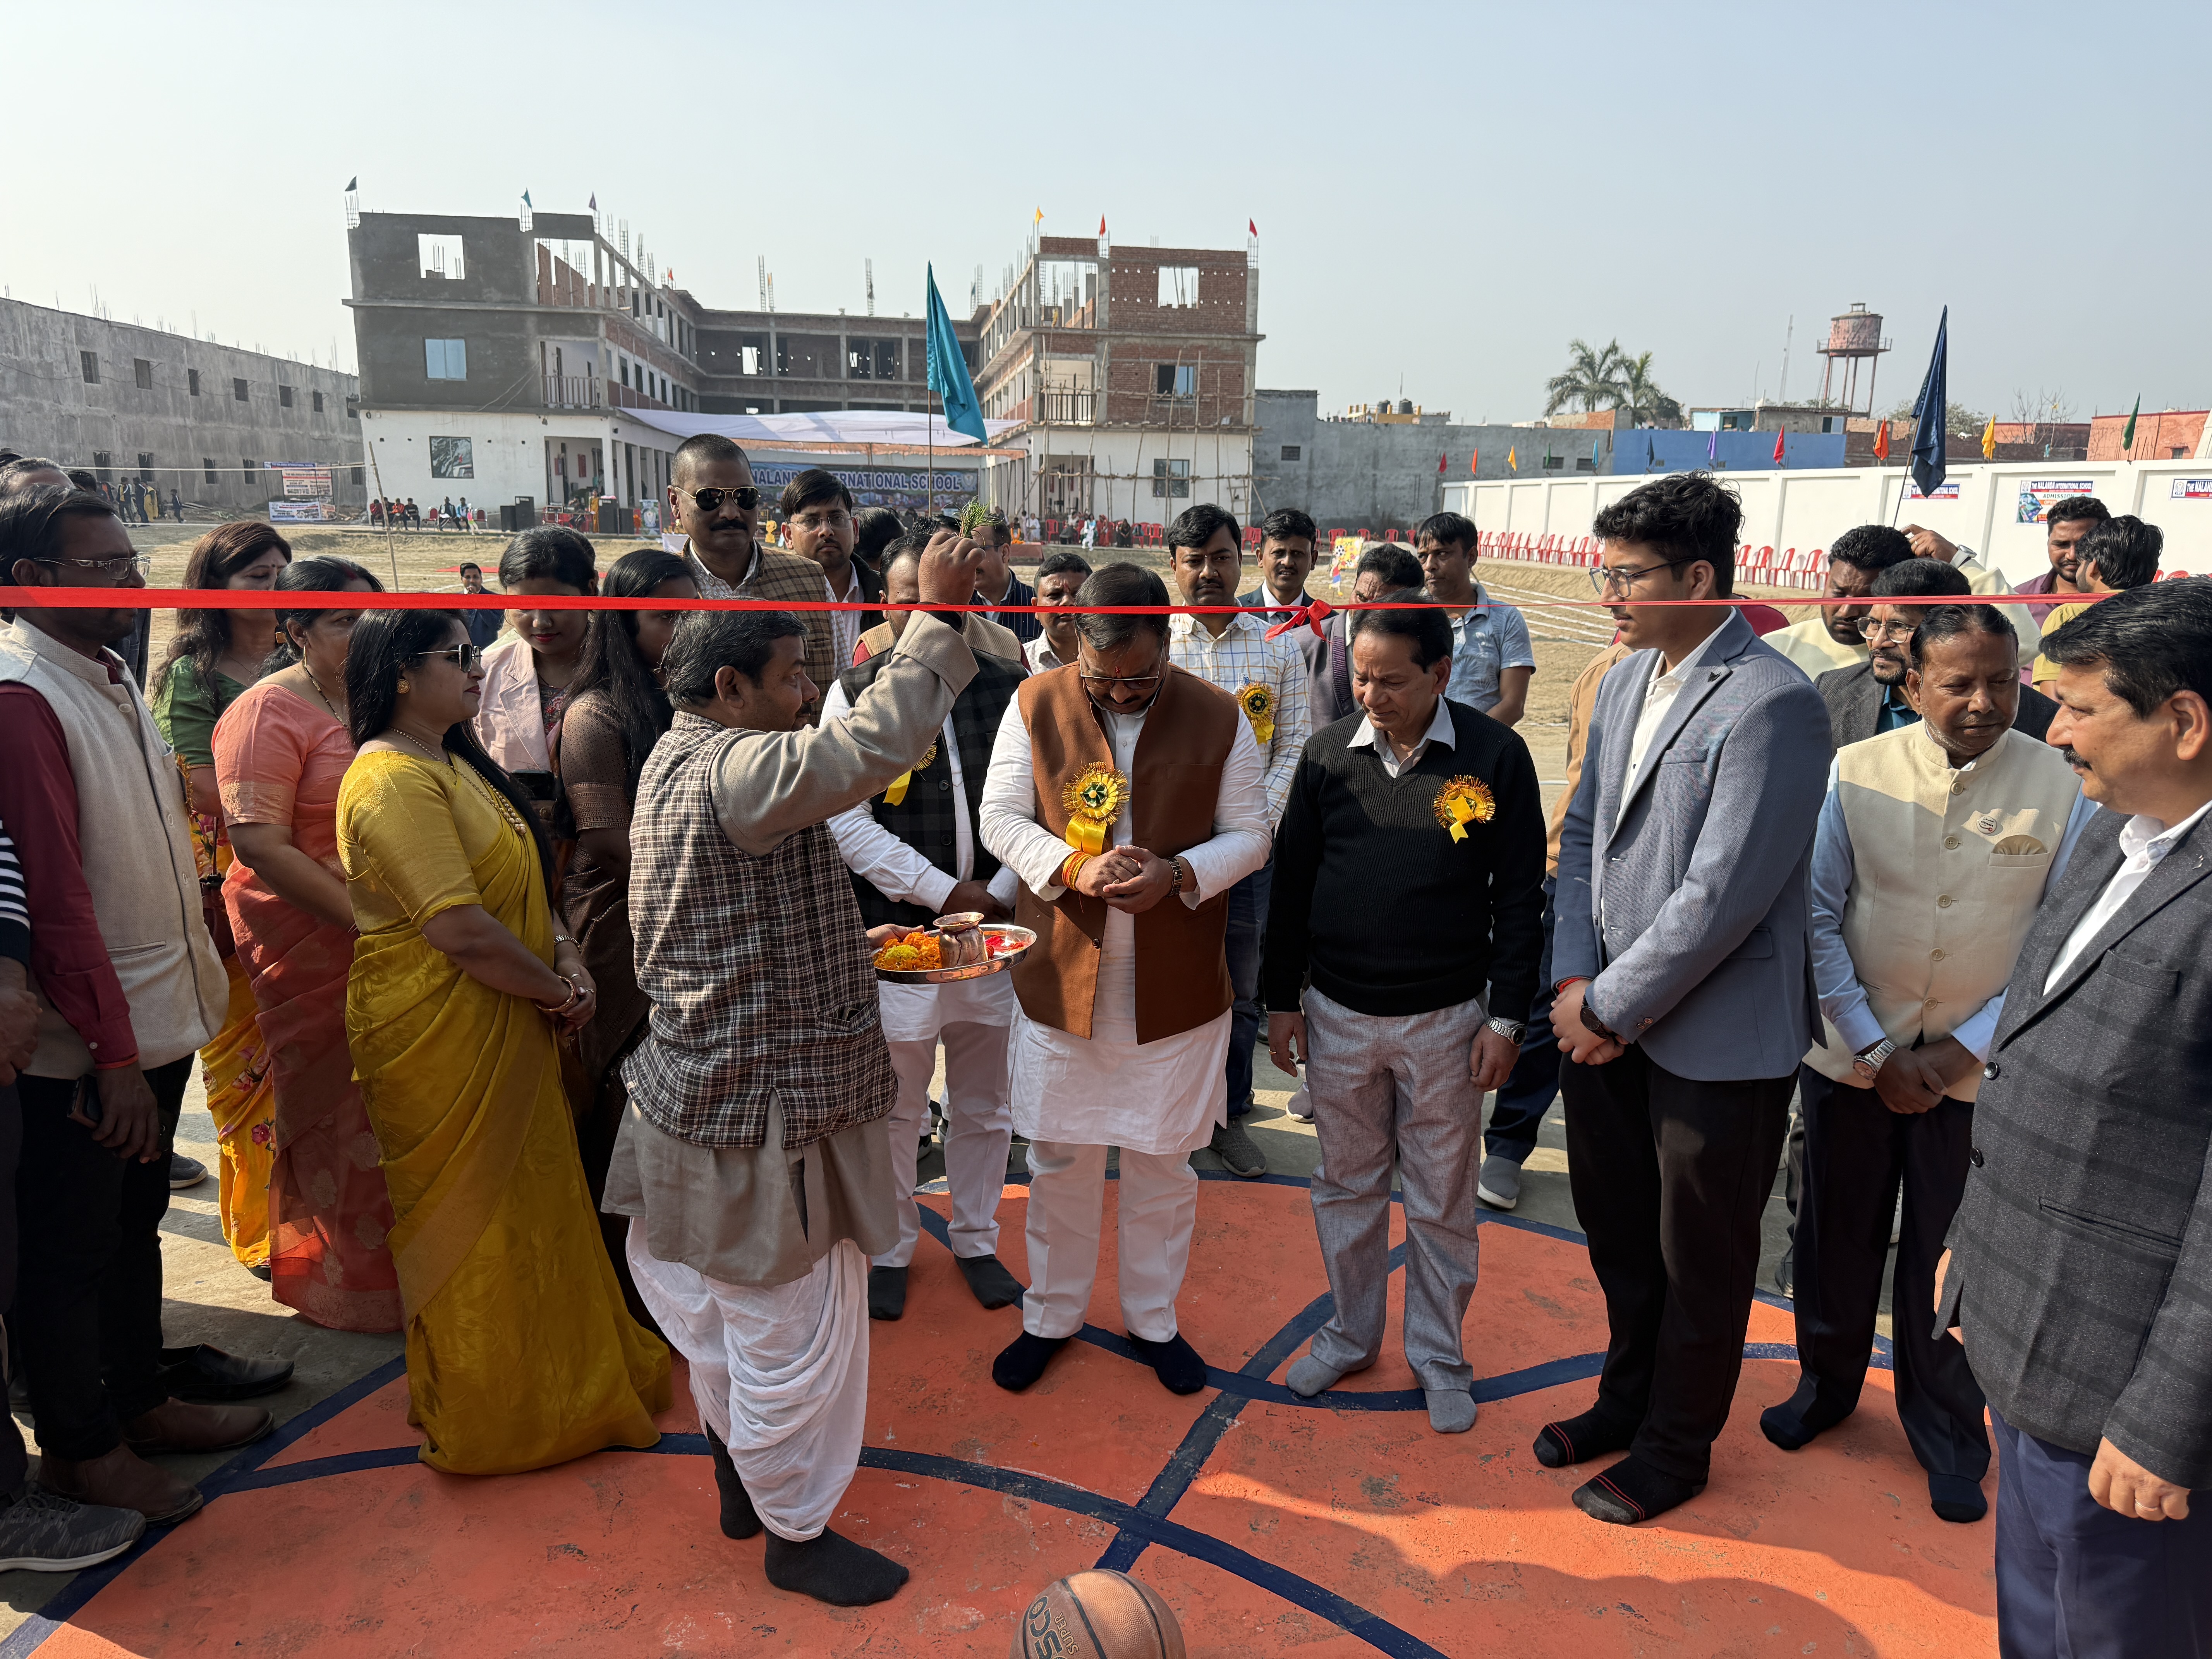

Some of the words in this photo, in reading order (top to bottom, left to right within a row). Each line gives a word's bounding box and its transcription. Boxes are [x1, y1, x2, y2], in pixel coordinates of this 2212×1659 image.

[752, 470, 799, 485] NALAND
[911, 473, 960, 490] SCHOOL
[2038, 481, 2055, 489] NALANDA
[2186, 483, 2195, 492] THE
[2194, 481, 2212, 492] NALAN
[1028, 1596, 1067, 1659] SCO
[1054, 1612, 1079, 1655] SUPER
